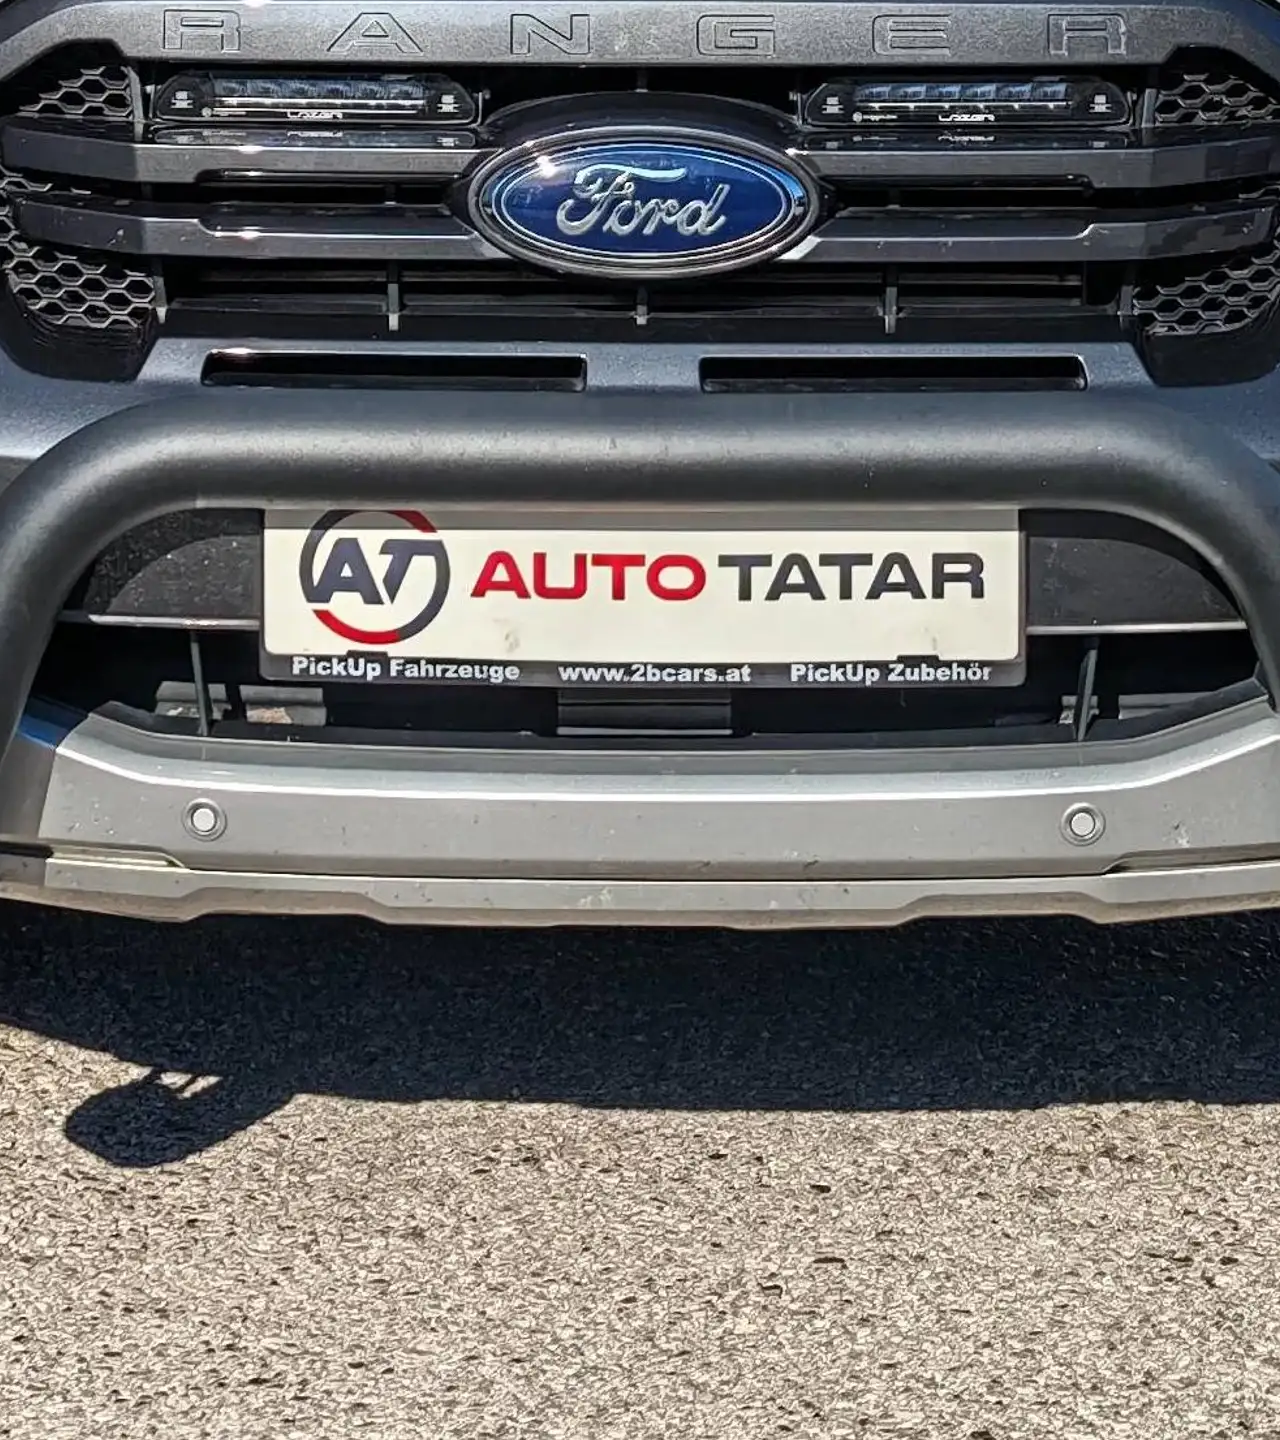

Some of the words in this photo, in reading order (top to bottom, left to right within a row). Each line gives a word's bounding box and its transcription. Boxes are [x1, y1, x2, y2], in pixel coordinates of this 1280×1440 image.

[163, 9, 1127, 57] RANGER
[556, 163, 731, 236] Ford
[305, 537, 445, 605] AT
[470, 550, 707, 602] AUTO
[718, 551, 985, 602] TATAR
[291, 655, 382, 682] PickUp
[390, 657, 520, 683] Fahrzeuge
[558, 662, 752, 684] www.2bcars.at
[790, 662, 880, 687] PickUp
[887, 661, 993, 683] Zubehör
